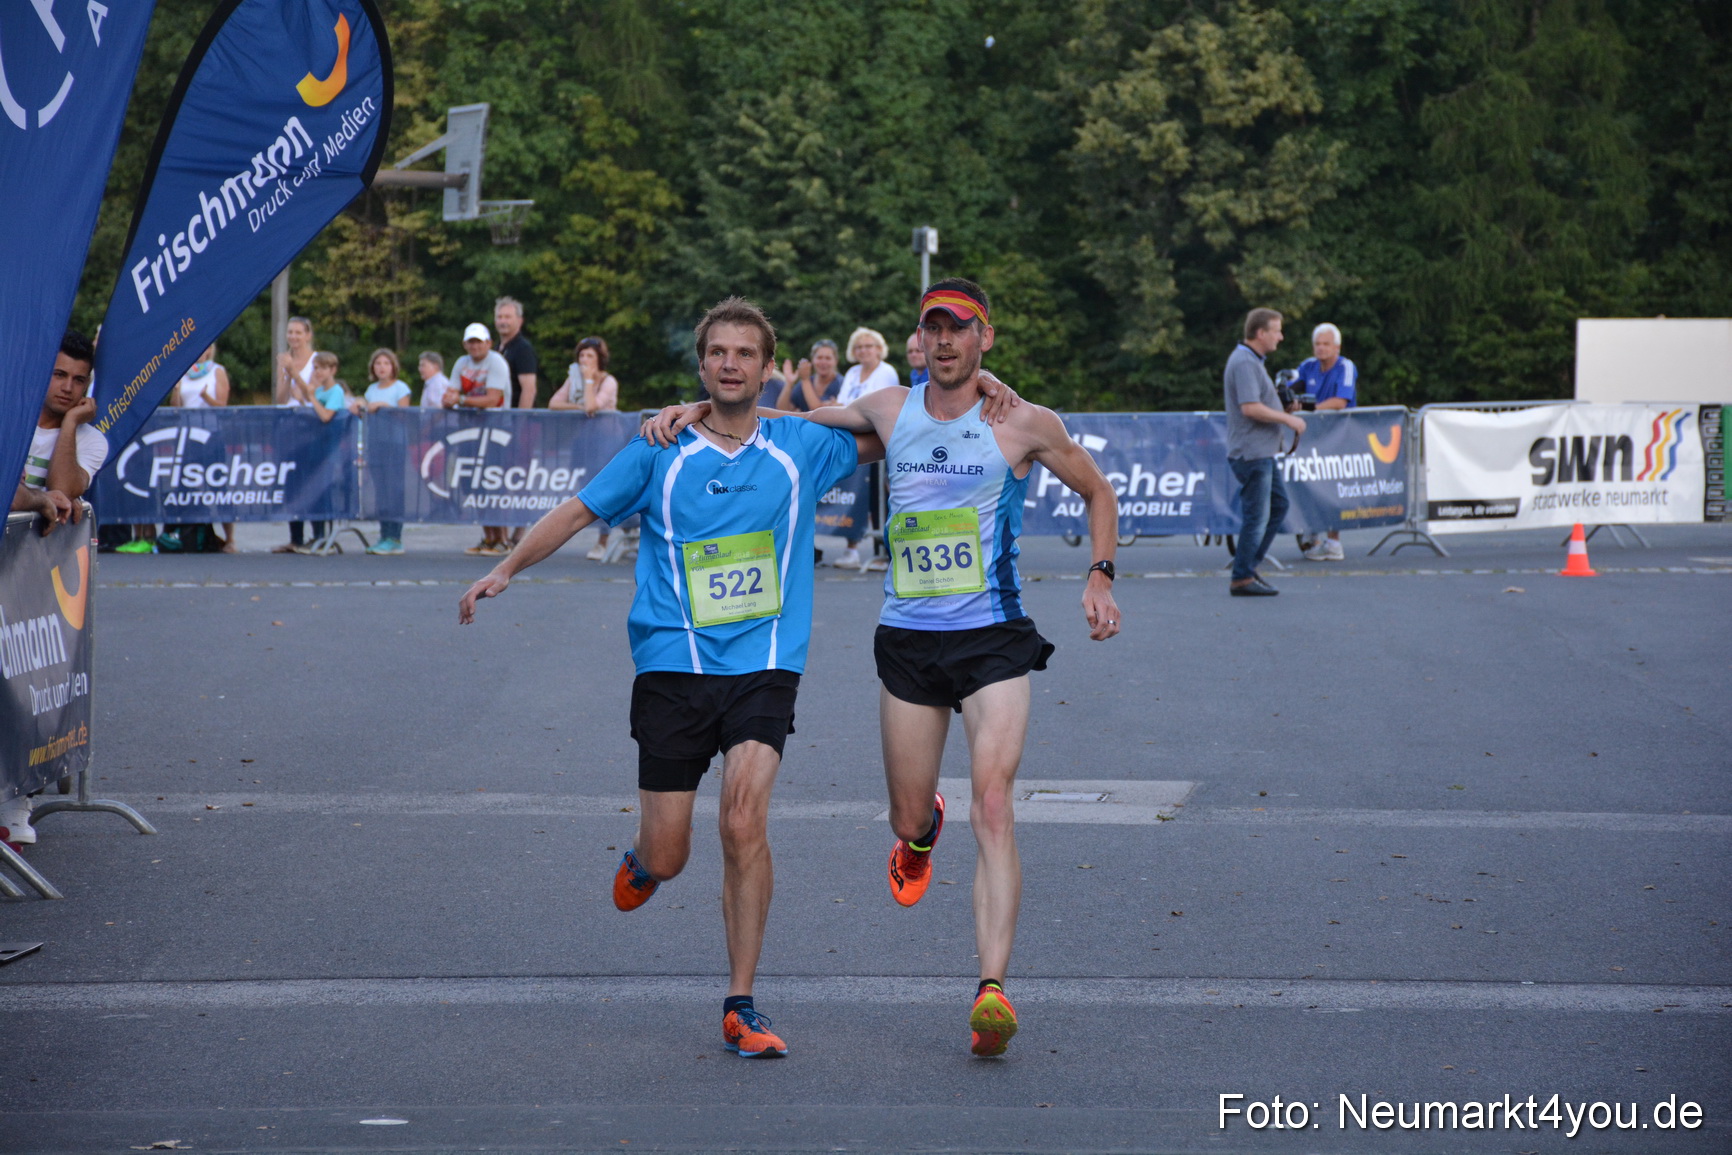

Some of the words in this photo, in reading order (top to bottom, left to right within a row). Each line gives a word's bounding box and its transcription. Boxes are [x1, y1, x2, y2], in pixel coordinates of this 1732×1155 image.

[248, 178, 293, 233] Druck
[323, 96, 375, 165] Medien
[131, 116, 314, 315] Frischmann
[896, 462, 985, 476] SCHABMÜLLER
[1528, 435, 1635, 487] swn
[149, 454, 296, 488] Fischer
[451, 458, 586, 491] Fischer
[730, 484, 758, 493] classic
[924, 478, 948, 487] TEAM
[1337, 482, 1361, 499] Druck
[1362, 480, 1378, 496] und
[163, 490, 285, 506] AUTOMOBILE
[1605, 488, 1669, 506] neumarkt
[1052, 500, 1192, 518] AUMOBILE
[901, 541, 973, 574] 1336
[708, 566, 764, 601] 522
[935, 576, 955, 584] Schön
[721, 602, 744, 612] Michael
[744, 601, 757, 609] Lang
[28, 678, 53, 717] Druck
[52, 671, 70, 709] und
